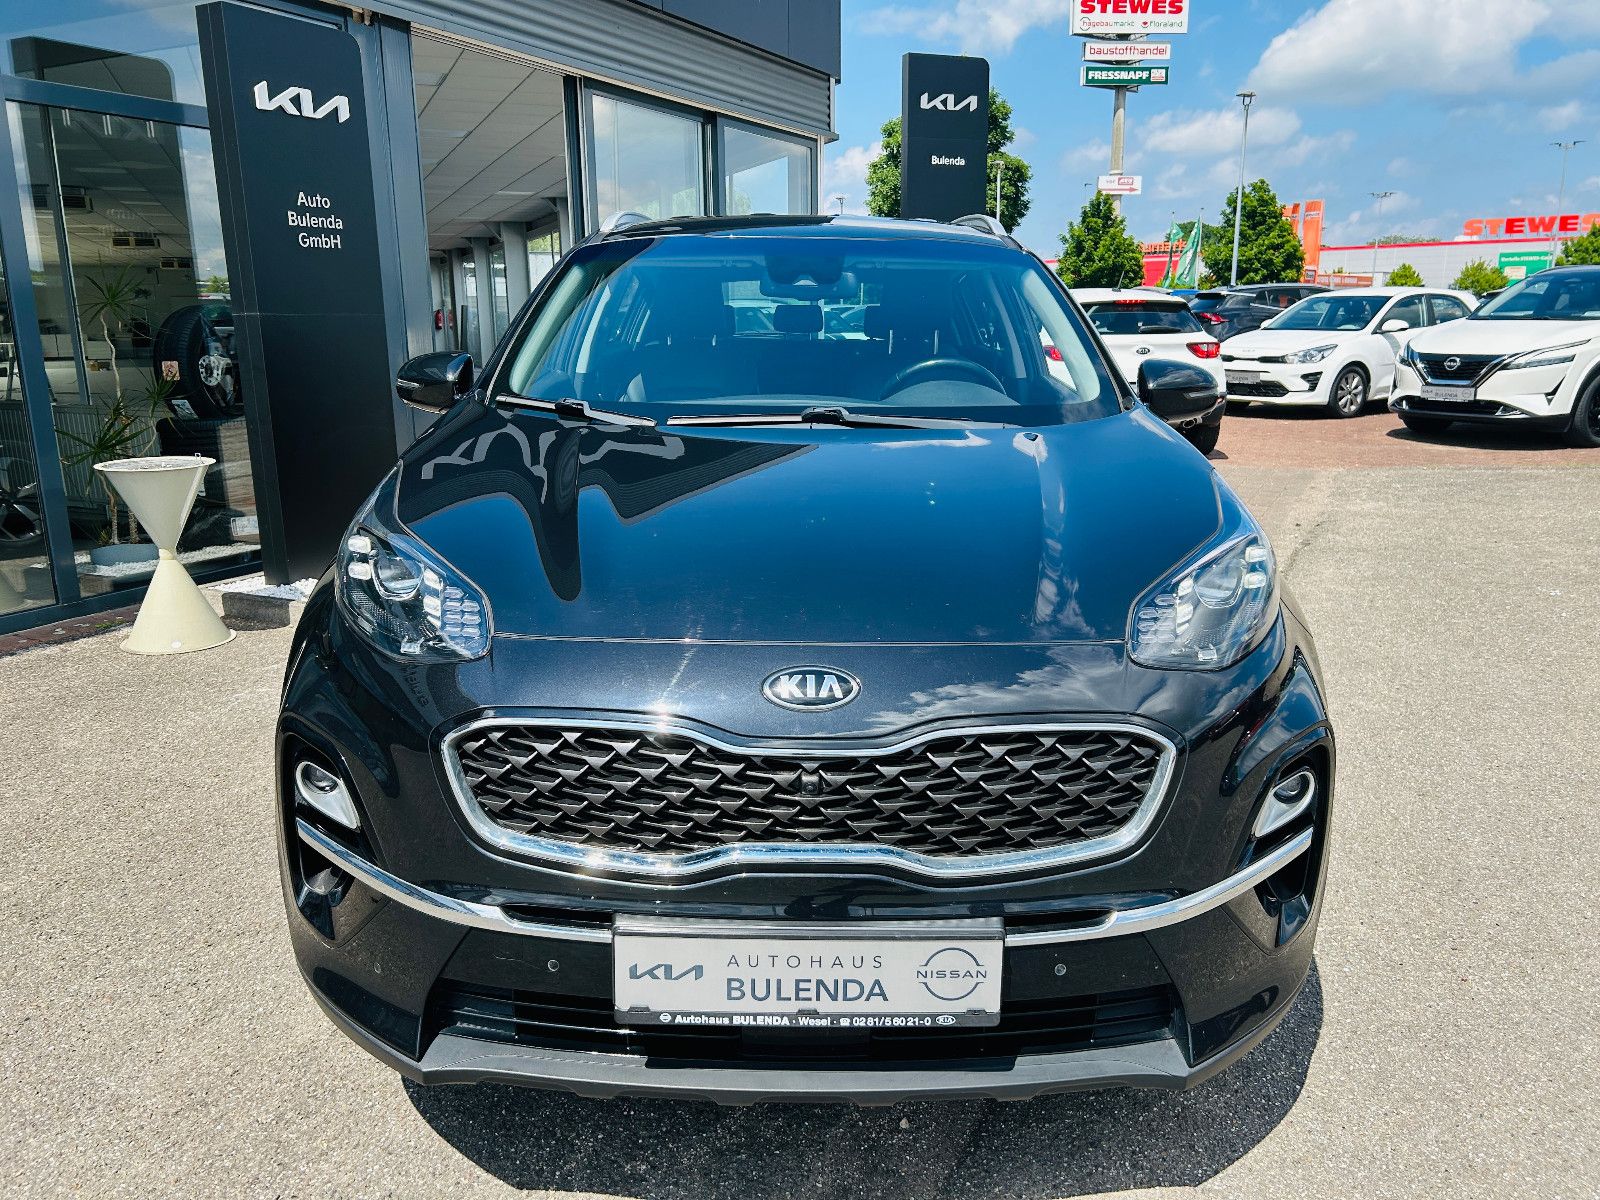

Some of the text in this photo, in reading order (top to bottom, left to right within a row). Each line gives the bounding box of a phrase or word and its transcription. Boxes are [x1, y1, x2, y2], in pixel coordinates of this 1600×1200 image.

[1080, 0, 1184, 14] STEWES
[1089, 45, 1168, 55] baustoffhandel
[1088, 70, 1149, 80] FRESSNAPF
[253, 80, 351, 124] KIA
[920, 92, 978, 112] KIA
[931, 155, 966, 166] Bulenda
[297, 191, 331, 209] Auto
[287, 210, 344, 230] Bulenda
[298, 232, 342, 249] GmbH
[779, 674, 844, 699] KIA
[726, 954, 883, 969] AUTOHAUS
[628, 962, 704, 981] KIA
[916, 970, 988, 979] NISSAN
[726, 977, 889, 1002] BULENDA
[674, 1014, 730, 1025] Autohaus
[732, 1015, 790, 1026] BULENDA
[798, 1017, 831, 1027] Wesel
[852, 1016, 932, 1027] 0281/56021-0
